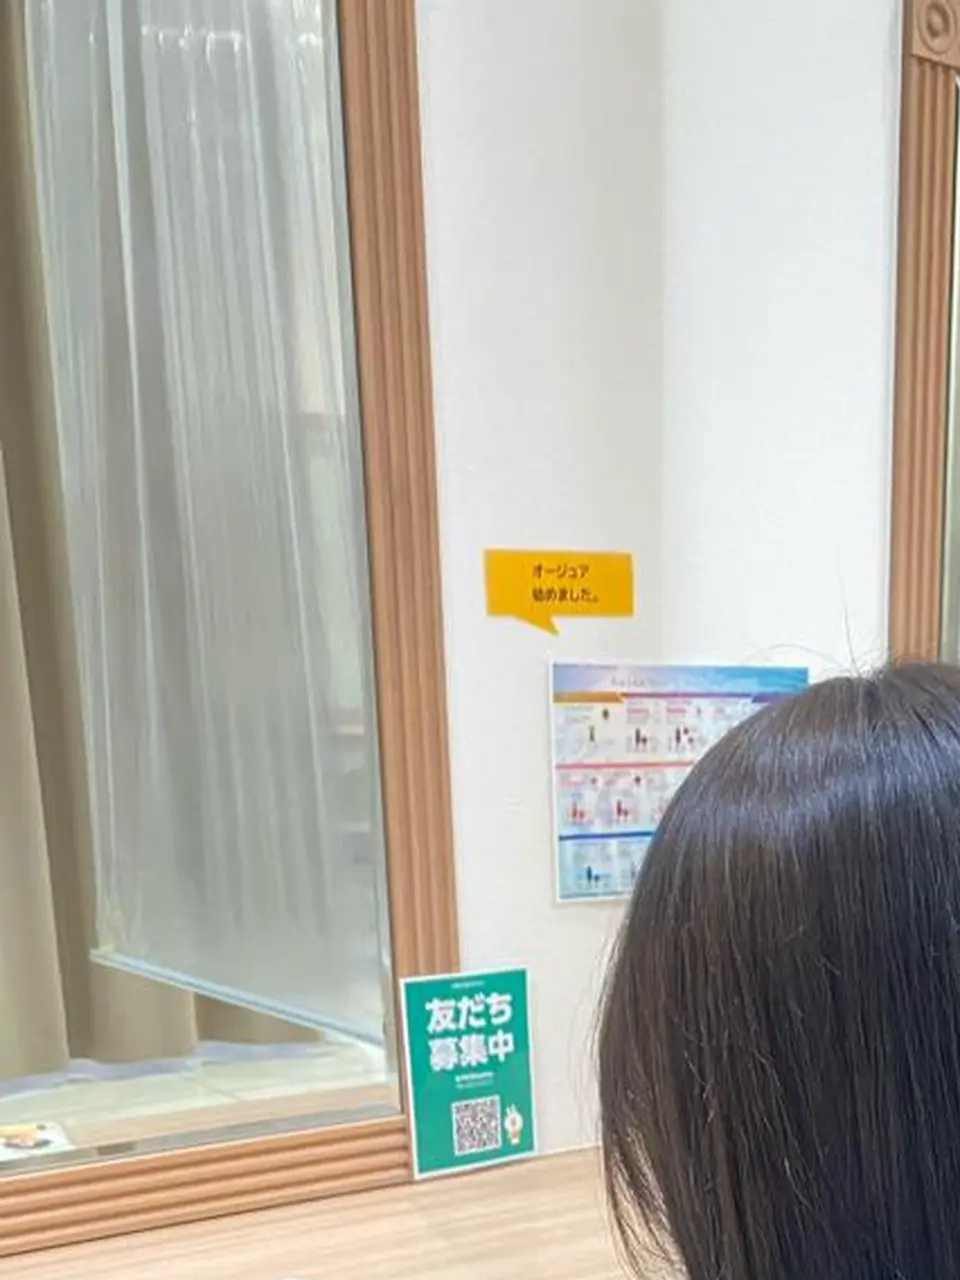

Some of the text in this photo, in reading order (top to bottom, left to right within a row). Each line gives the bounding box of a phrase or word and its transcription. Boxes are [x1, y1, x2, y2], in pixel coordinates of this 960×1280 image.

[532, 563, 590, 578] オージュア
[425, 991, 513, 1034] 友だち
[428, 1031, 515, 1071] 募集中
